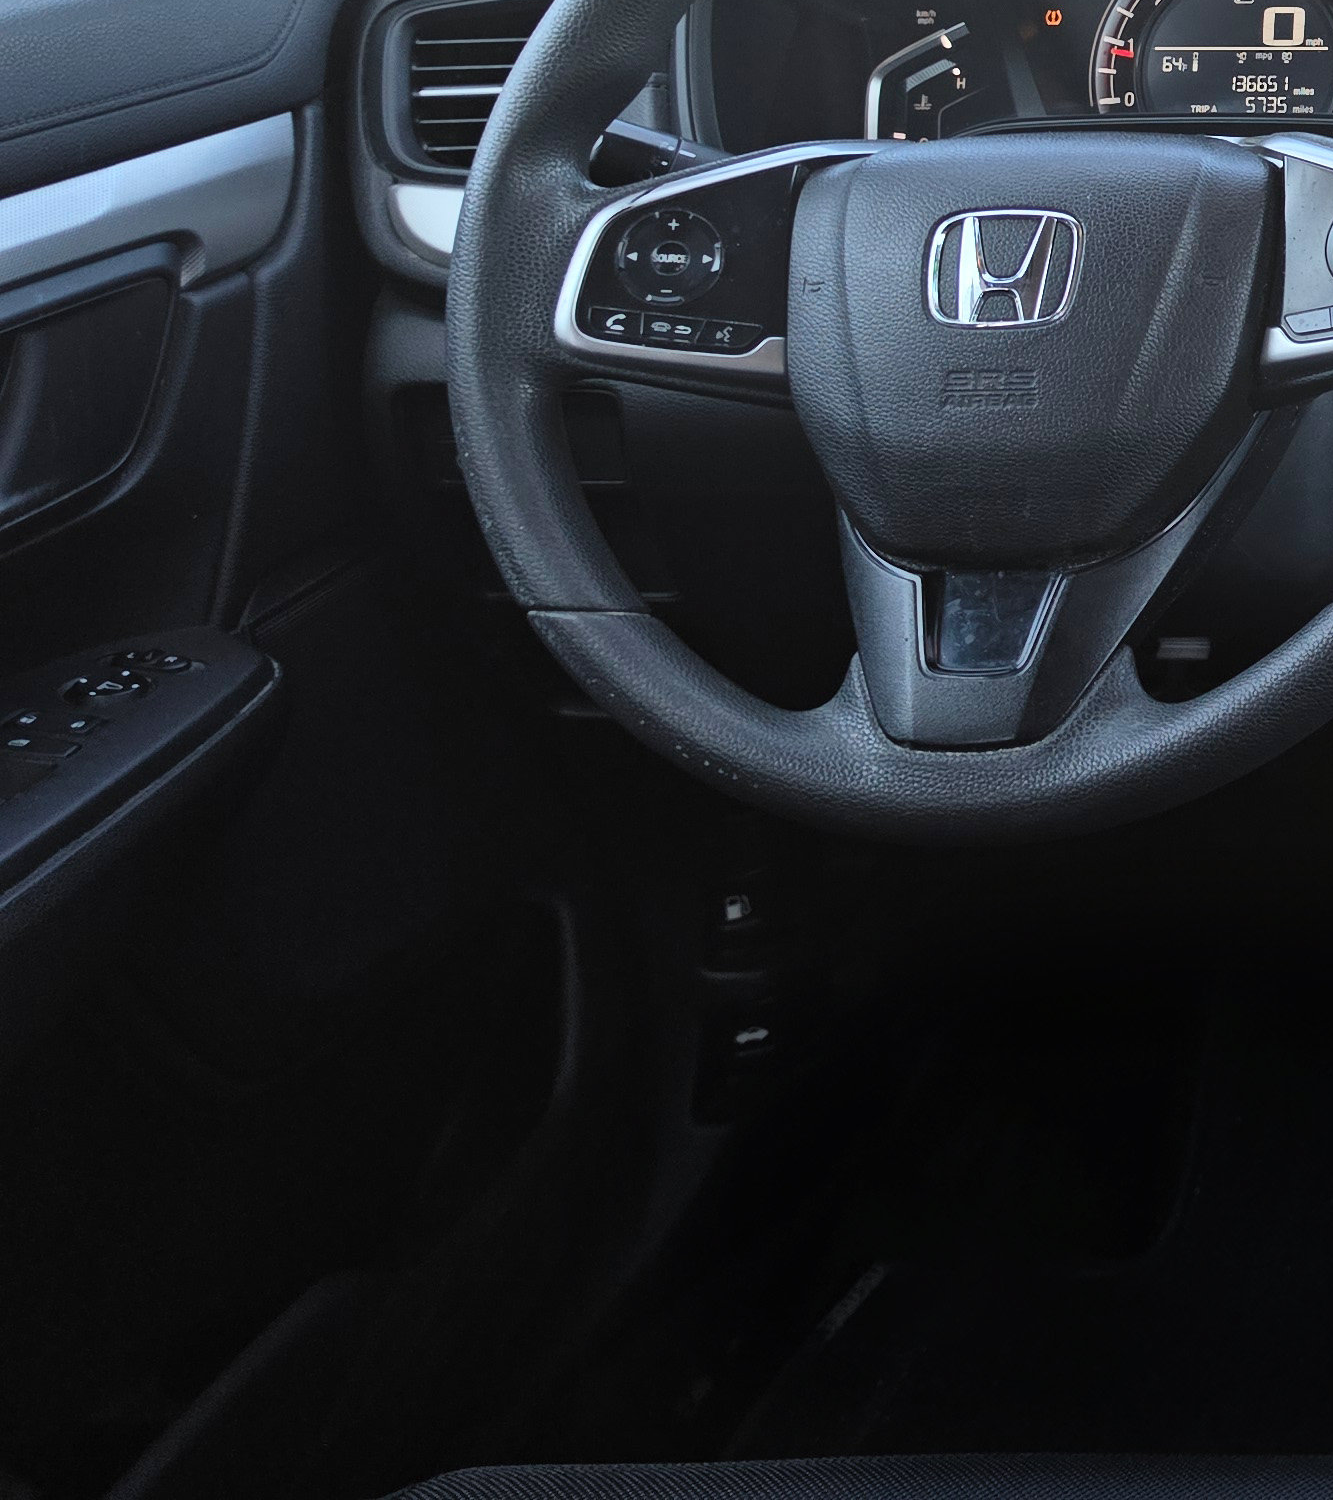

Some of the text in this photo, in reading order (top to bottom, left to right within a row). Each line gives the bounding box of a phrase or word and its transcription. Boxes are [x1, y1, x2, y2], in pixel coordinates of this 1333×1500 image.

[1263, 6, 1324, 48] 0 mph
[1255, 52, 1273, 61] mpg
[956, 77, 967, 90] H
[1231, 75, 1315, 96] 136651 miles
[1124, 91, 1136, 107] 0
[1190, 104, 1211, 114] TRIP
[1245, 96, 1288, 114] 5735
[1292, 105, 1314, 114] miles
[944, 369, 1039, 389] SRS
